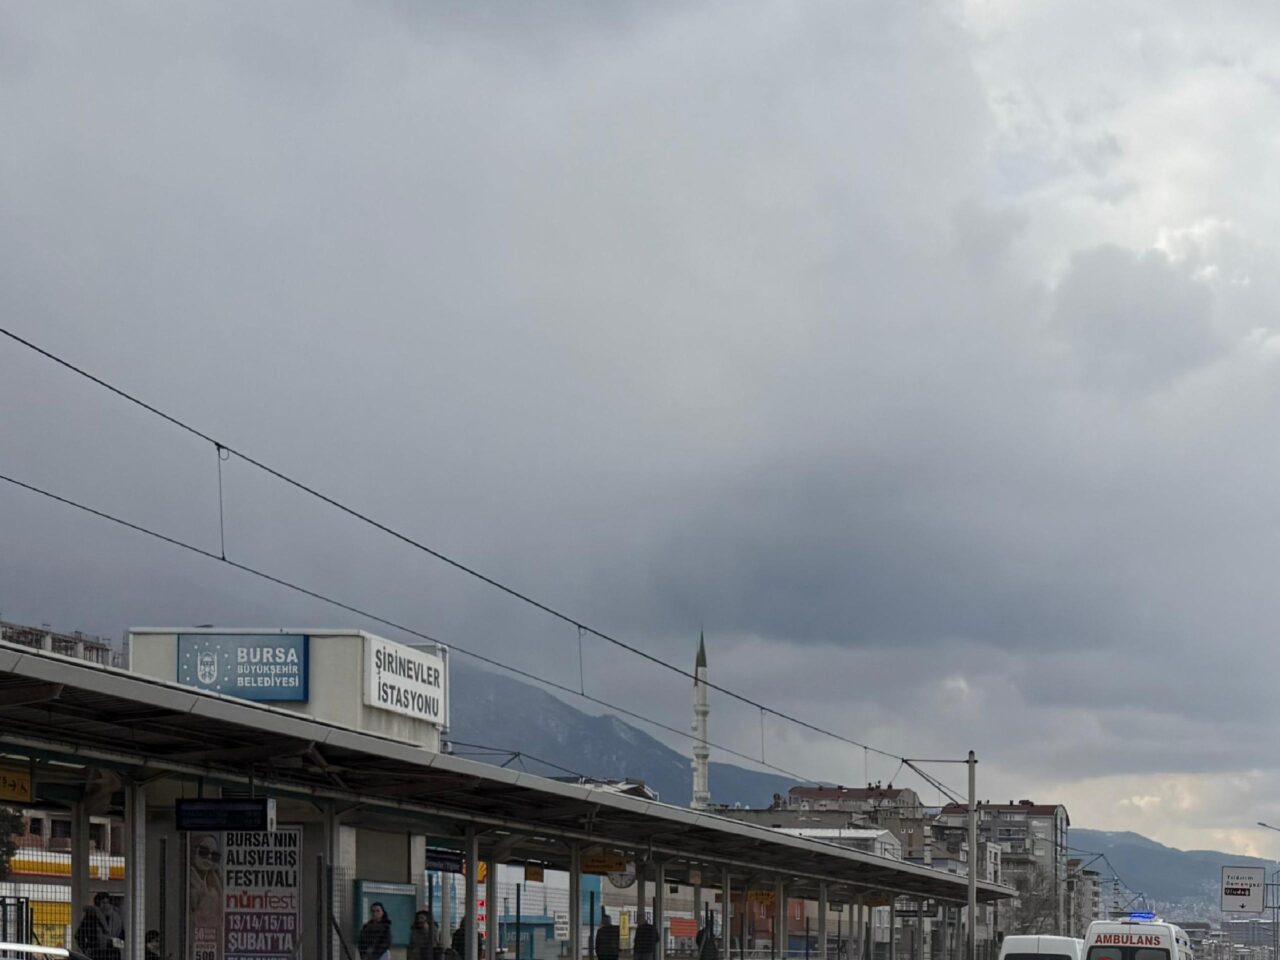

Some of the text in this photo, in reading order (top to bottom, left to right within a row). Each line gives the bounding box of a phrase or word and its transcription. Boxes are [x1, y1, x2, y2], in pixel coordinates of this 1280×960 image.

[237, 648, 299, 663] BURSA
[237, 663, 299, 676] BÜYÜKŞEHİR
[375, 646, 441, 689] ŞİRİNEVLER
[237, 675, 299, 687] BELEDİYESİ
[377, 676, 440, 717] İSTASYONU
[226, 832, 297, 847] BURSA'NIN
[226, 849, 298, 868] ALIŞVERİŞ
[226, 869, 298, 888] FESTİVALİ
[229, 914, 295, 931] 13/14/15/16
[228, 932, 293, 952] ŞUBAT'TA
[1095, 934, 1161, 945] AMBULANS
